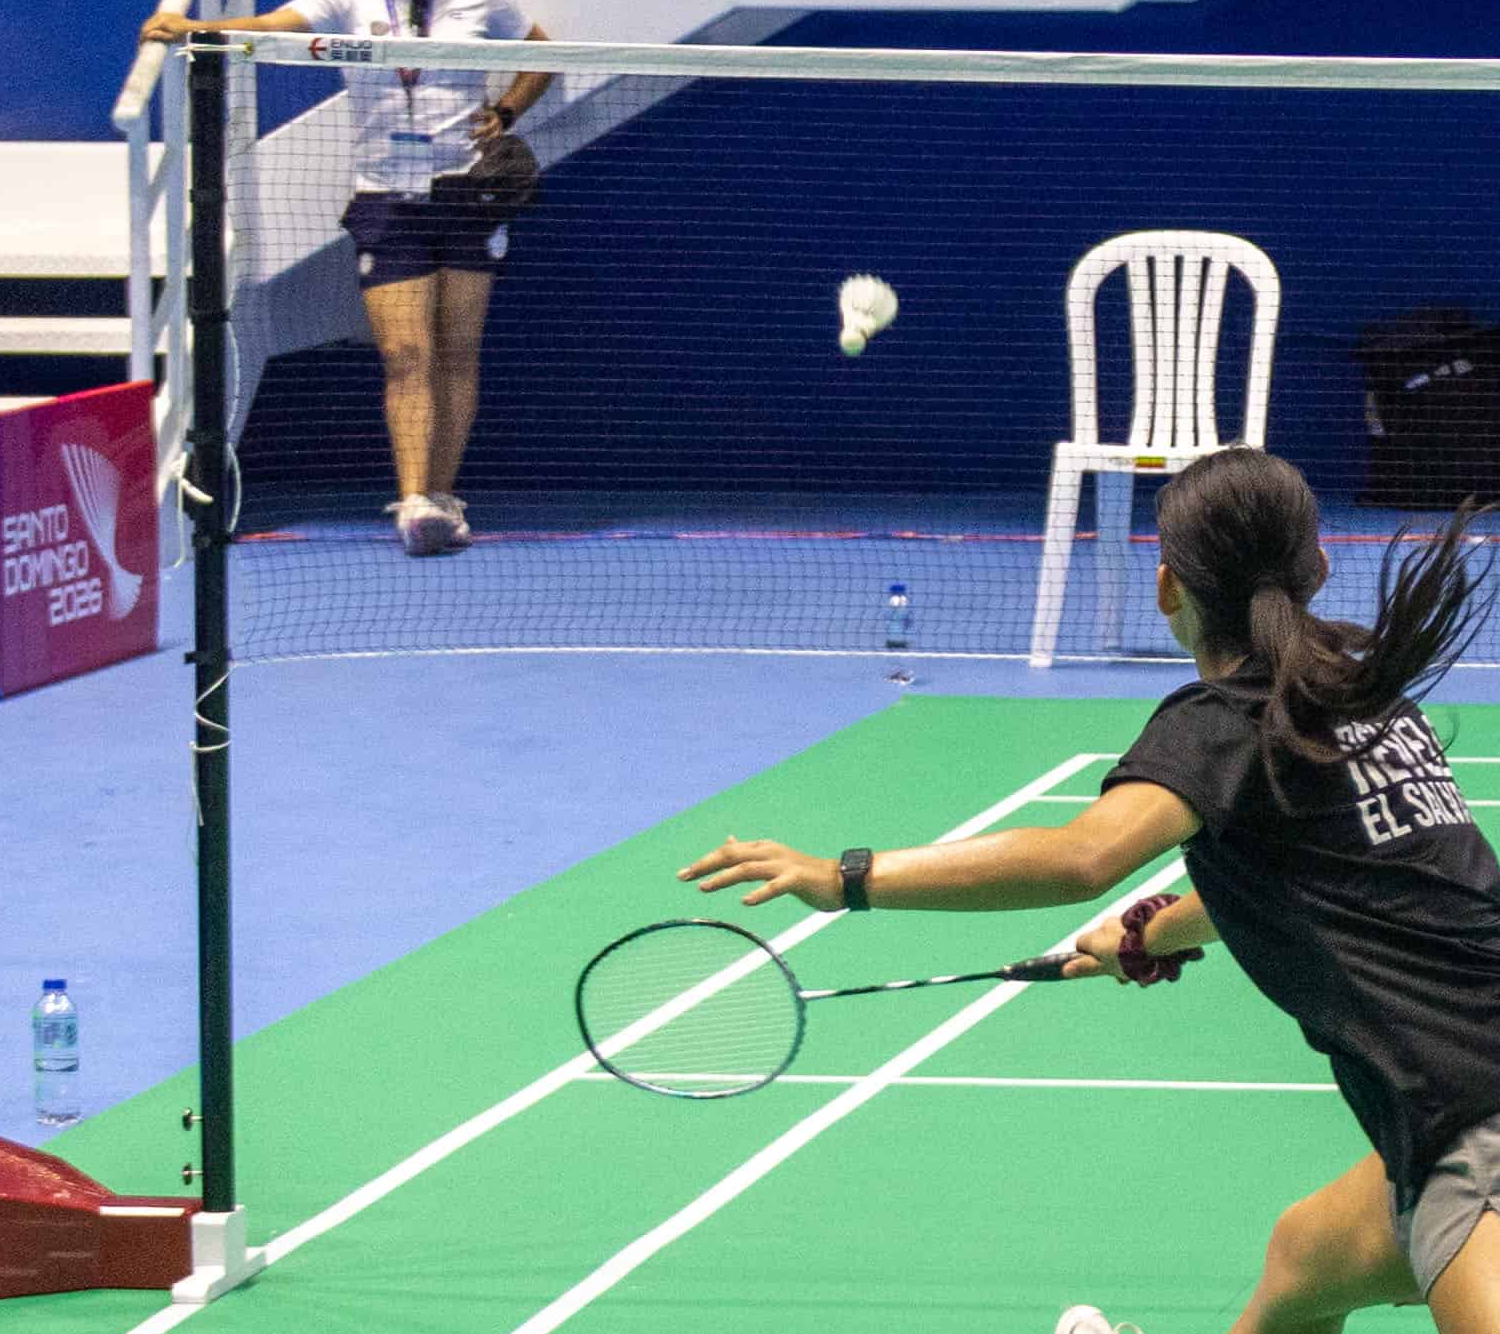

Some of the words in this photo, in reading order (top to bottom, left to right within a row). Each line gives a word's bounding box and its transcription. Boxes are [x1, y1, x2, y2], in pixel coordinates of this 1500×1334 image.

[3, 504, 68, 555] SANTO
[3, 540, 90, 597] DOMINGO
[50, 577, 103, 627] 2026
[1356, 793, 1413, 846] EL
